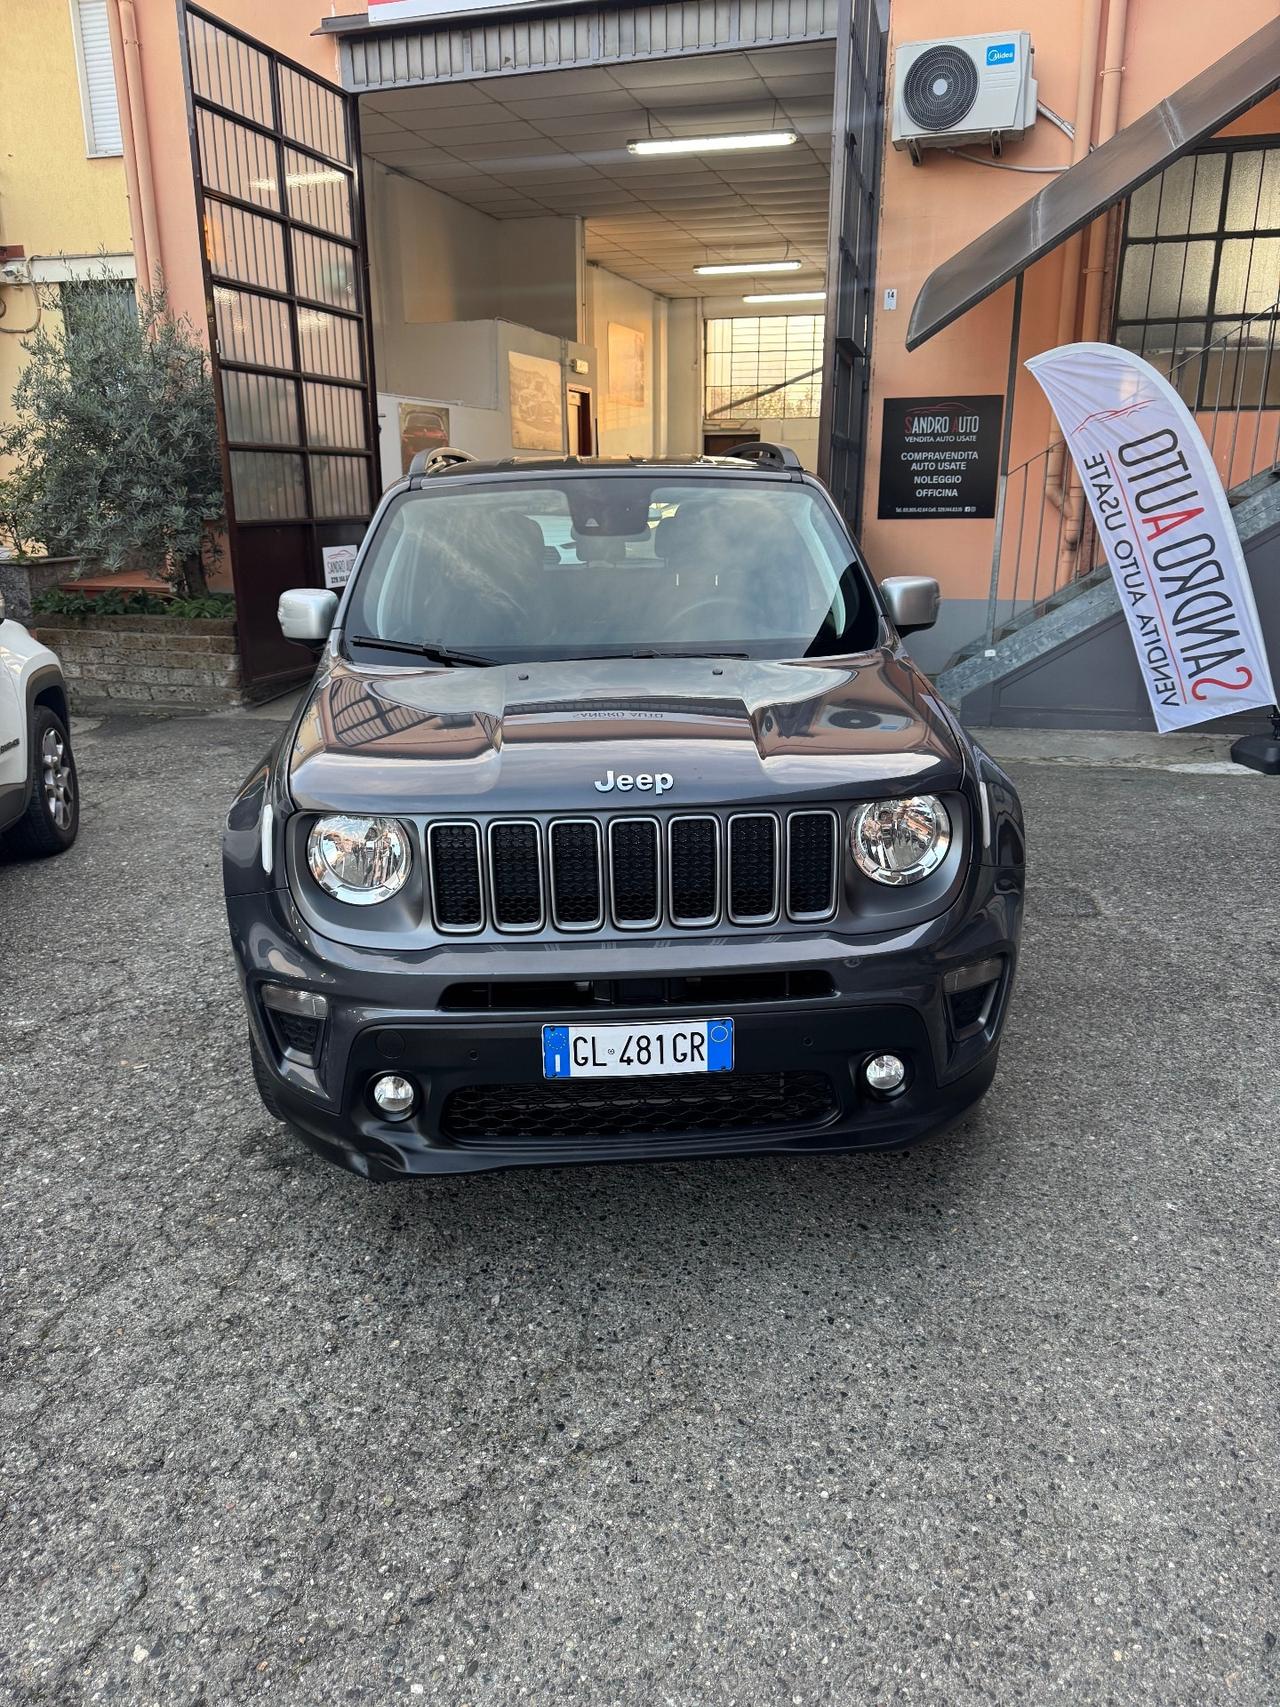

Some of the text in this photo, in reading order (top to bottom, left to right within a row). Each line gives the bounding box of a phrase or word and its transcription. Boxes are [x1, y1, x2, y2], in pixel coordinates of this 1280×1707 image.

[904, 415, 979, 433] SANDRO AUTO
[936, 435, 955, 443] AUTO
[901, 451, 979, 461] COMPRAVENDITA
[910, 461, 967, 471] AUTO USATE
[914, 475, 962, 484] NOLEGGIO
[915, 488, 958, 498] OFFICINA
[594, 770, 674, 795] Jeep
[573, 1036, 607, 1067] GL
